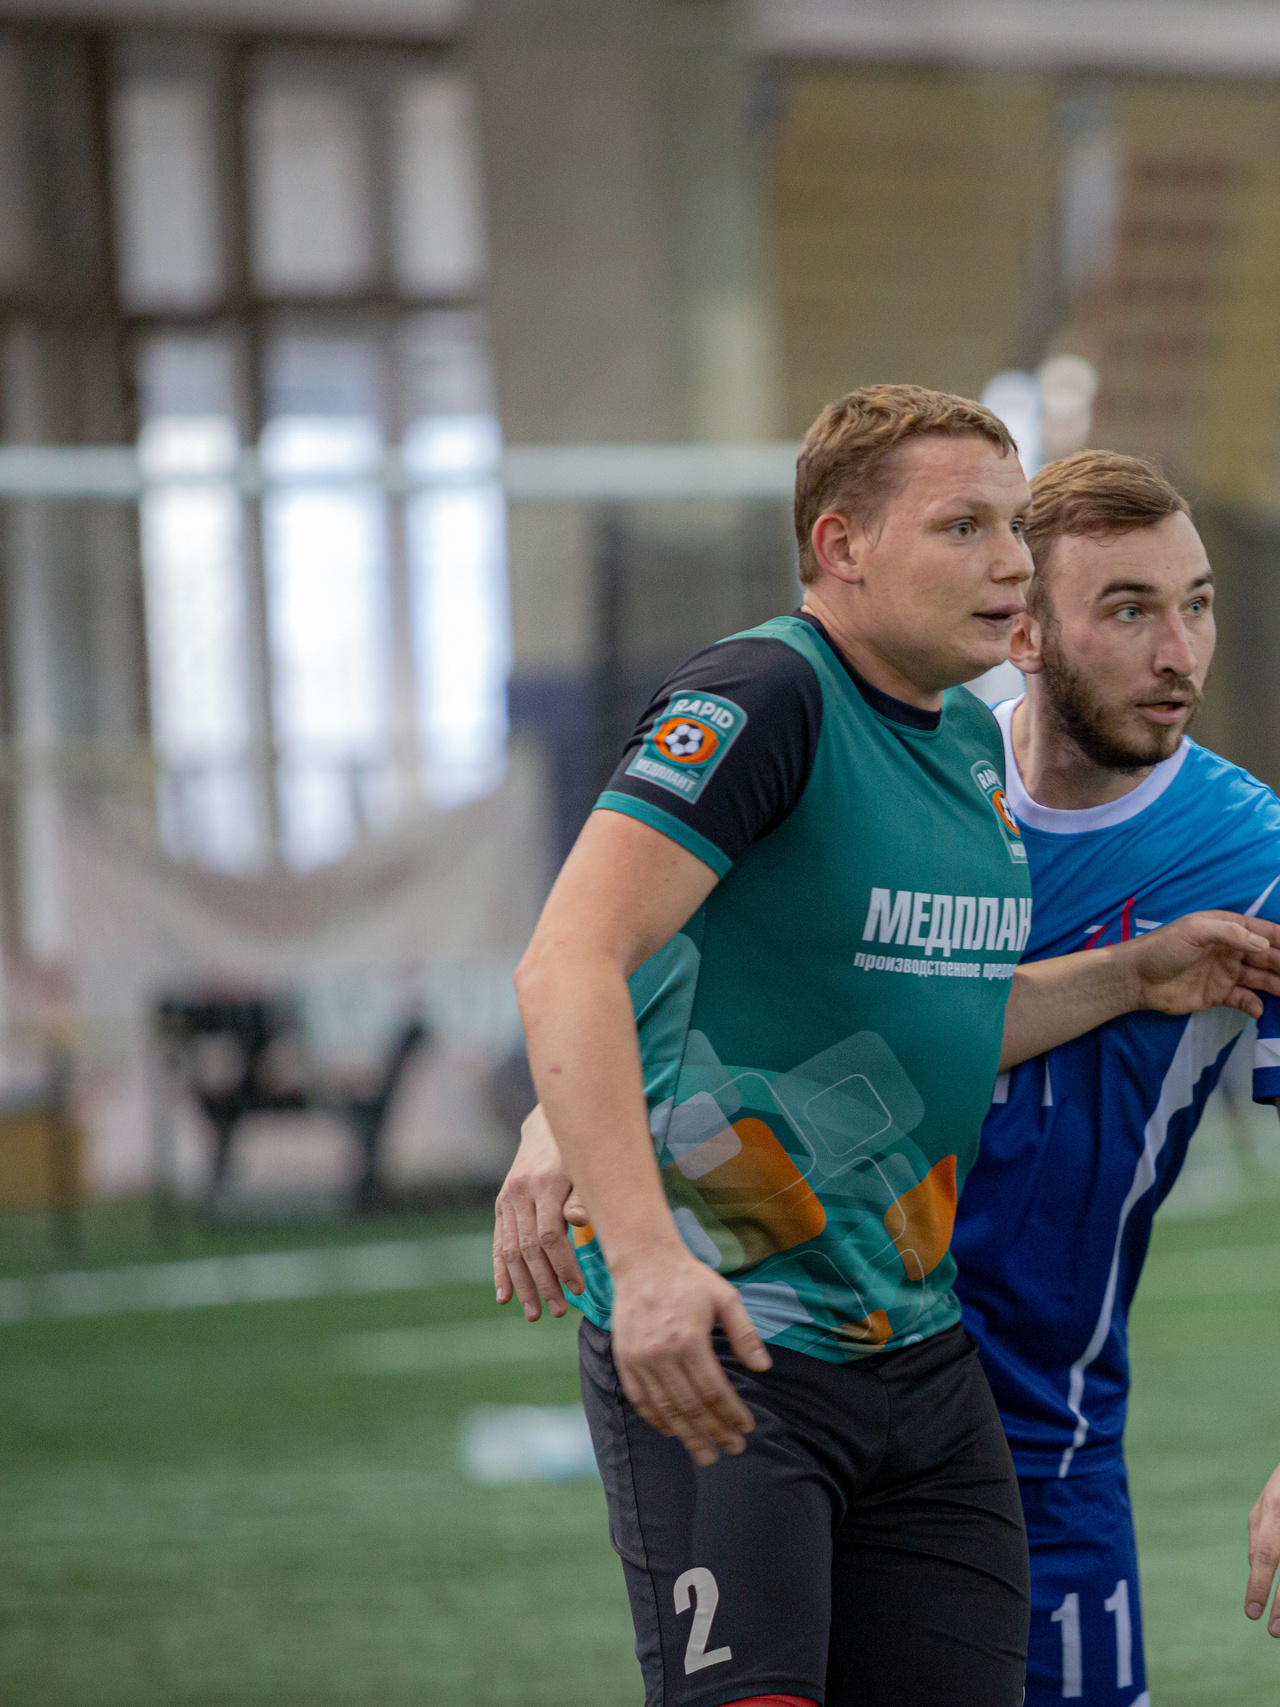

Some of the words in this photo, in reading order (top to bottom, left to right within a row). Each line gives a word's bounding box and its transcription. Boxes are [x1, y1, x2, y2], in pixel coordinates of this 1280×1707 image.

[671, 699, 734, 729] RAPID
[853, 952, 981, 978] производственное
[673, 1567, 732, 1675] 2
[1050, 1579, 1132, 1698] 11
